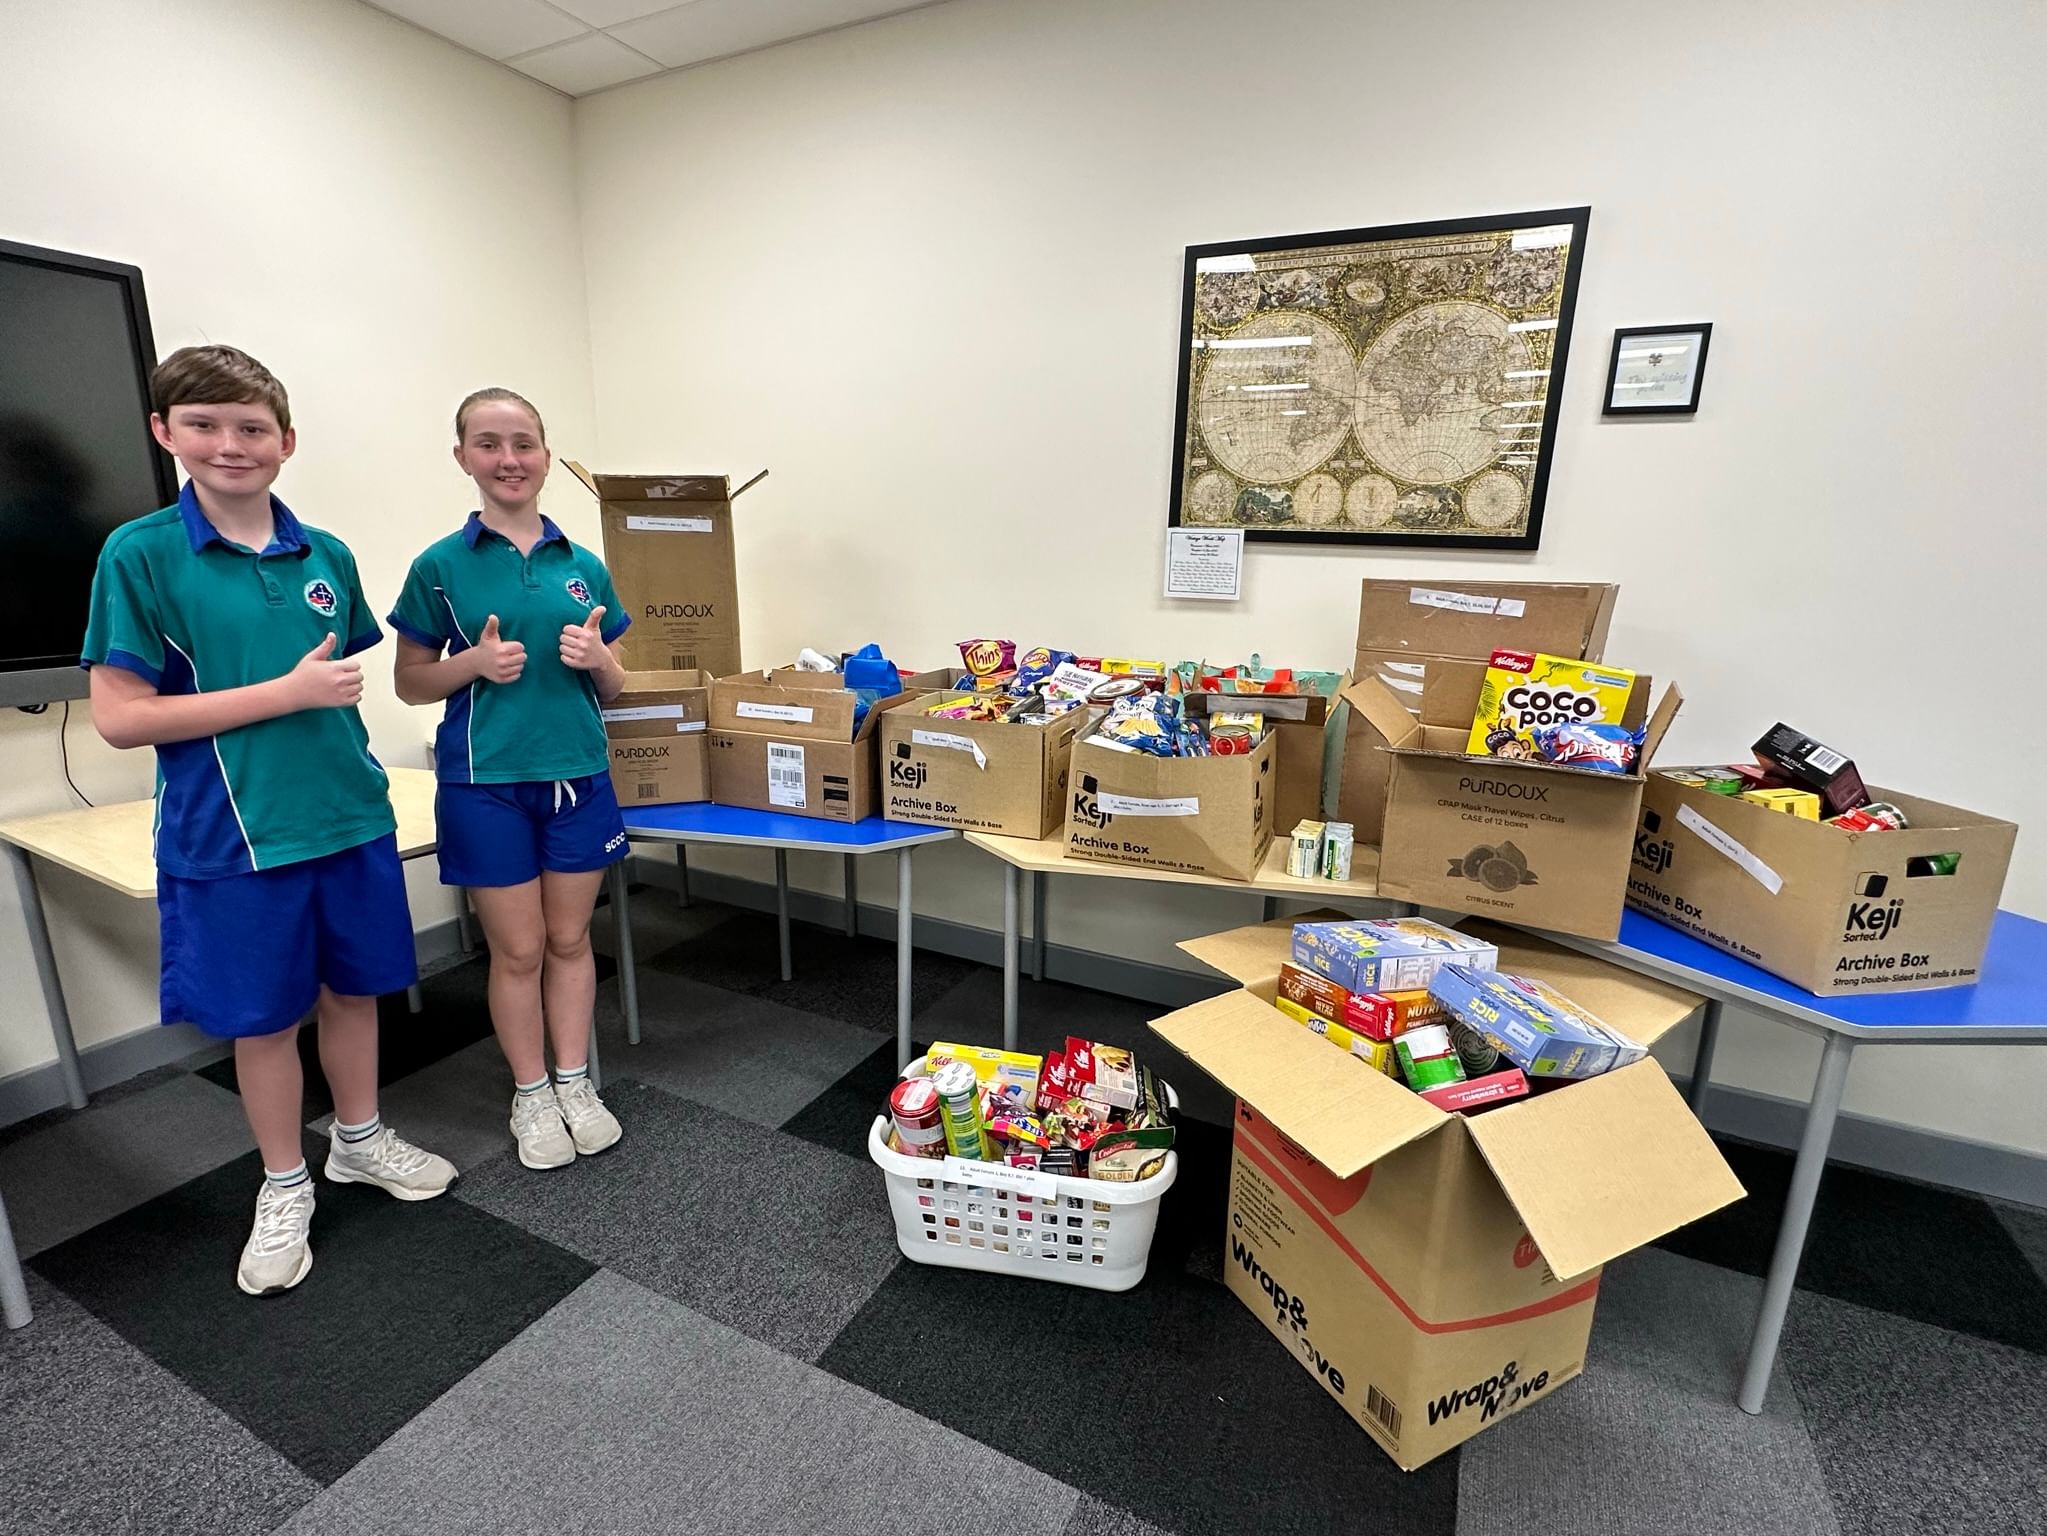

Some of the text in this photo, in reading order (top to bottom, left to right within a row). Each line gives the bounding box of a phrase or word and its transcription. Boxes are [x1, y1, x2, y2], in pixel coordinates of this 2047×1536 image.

[966, 644, 1001, 673] Thins
[1494, 656, 1530, 671] Kellogg's
[1507, 687, 1598, 718] COCO
[1487, 731, 1510, 744] COCO
[890, 760, 927, 789] Keji
[890, 780, 915, 789] Sorted.
[890, 796, 958, 814] Archive Box
[1437, 799, 1460, 809] CPAP
[1460, 802, 1482, 813] Mask
[1484, 805, 1508, 816] Travel
[1540, 812, 1566, 824] Citrus
[891, 809, 910, 819] Strong
[911, 812, 950, 823] Double-Sided
[951, 817, 963, 825] End
[1072, 814, 1098, 829] Sorted.
[1461, 812, 1529, 830] CASE of 12 boxes
[604, 831, 626, 853] SCCC
[1070, 832, 1150, 855] Archive Box
[1070, 847, 1093, 857] Strong
[1094, 851, 1141, 863] Double-Sided
[1142, 857, 1157, 865] End
[1633, 833, 1675, 875] Keji
[1631, 857, 1657, 873] orted.
[1465, 894, 1516, 910] CITRUS SCENT
[1627, 874, 1703, 920] Archive Box
[1845, 899, 1905, 940] Keji
[1691, 922, 1706, 936] End
[1707, 930, 1729, 946] Walls
[1730, 941, 1738, 949] &
[1740, 945, 1762, 960] Base
[1842, 931, 1878, 943] Sorted.
[1835, 953, 1930, 972] Archive Box
[1365, 963, 1376, 988] RICE
[1832, 968, 1976, 987] Strong Double-Sided End Walls & Base
[1406, 1003, 1441, 1019] NUTRI
[1468, 996, 1500, 1024] RICE
[1383, 1006, 1395, 1038] Kellogg's
[1026, 1122, 1045, 1137] LIFE
[1098, 1172, 1134, 1181] GOLDEN
[1427, 1360, 1519, 1426] Wrap&
